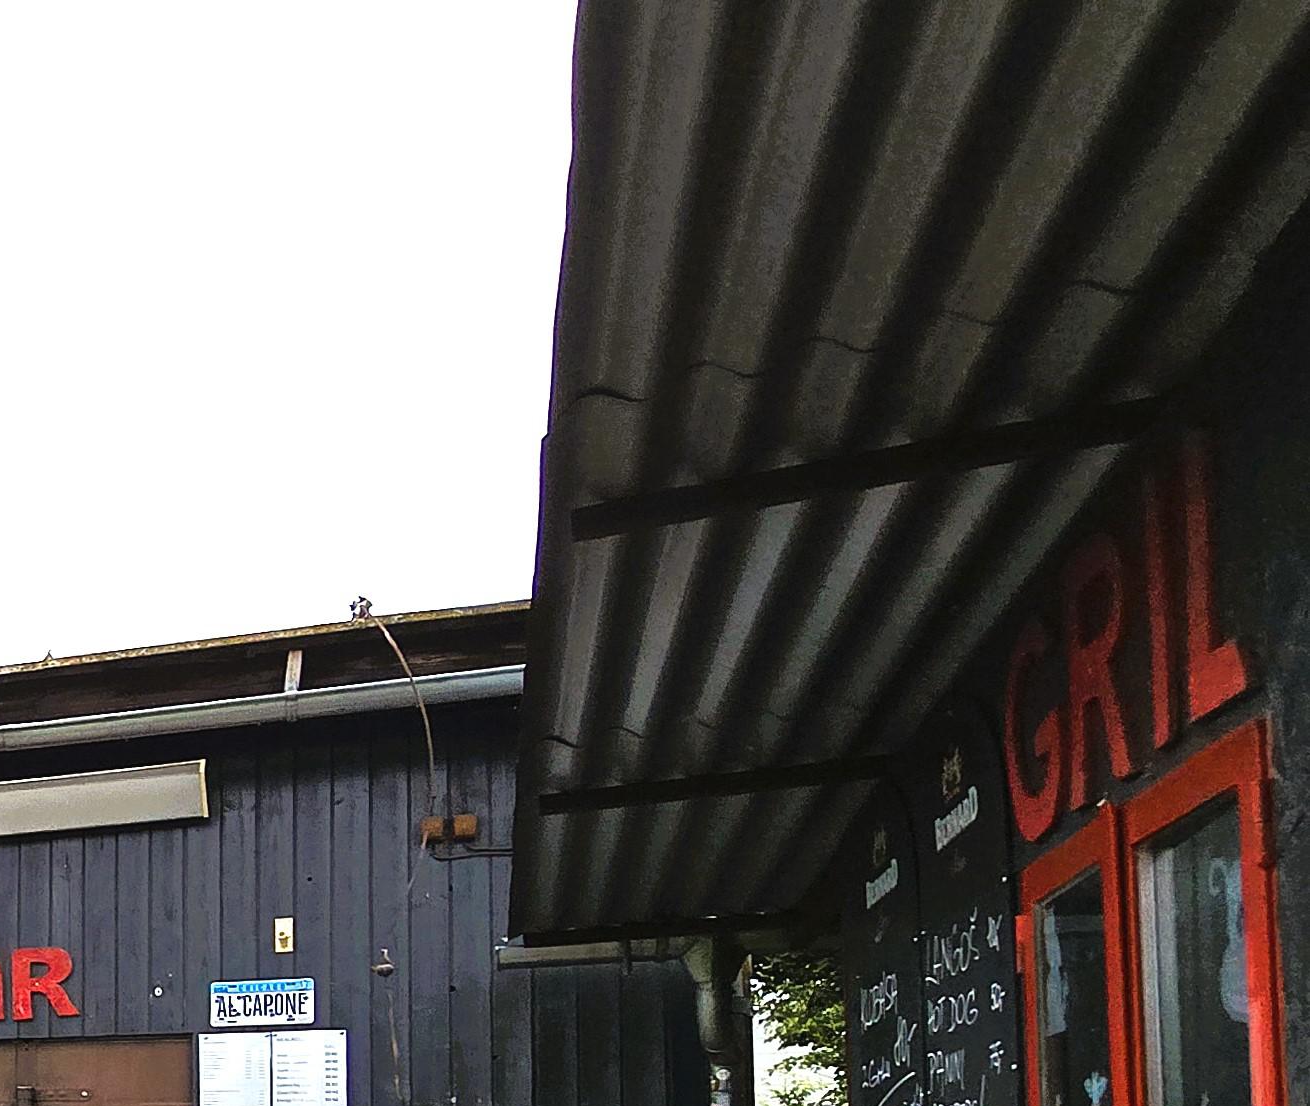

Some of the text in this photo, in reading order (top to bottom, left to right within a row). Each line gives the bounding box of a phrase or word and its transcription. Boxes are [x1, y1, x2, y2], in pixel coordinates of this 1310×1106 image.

[1005, 448, 1247, 842] GRIL
[216, 992, 308, 1018] AL CAPONE
